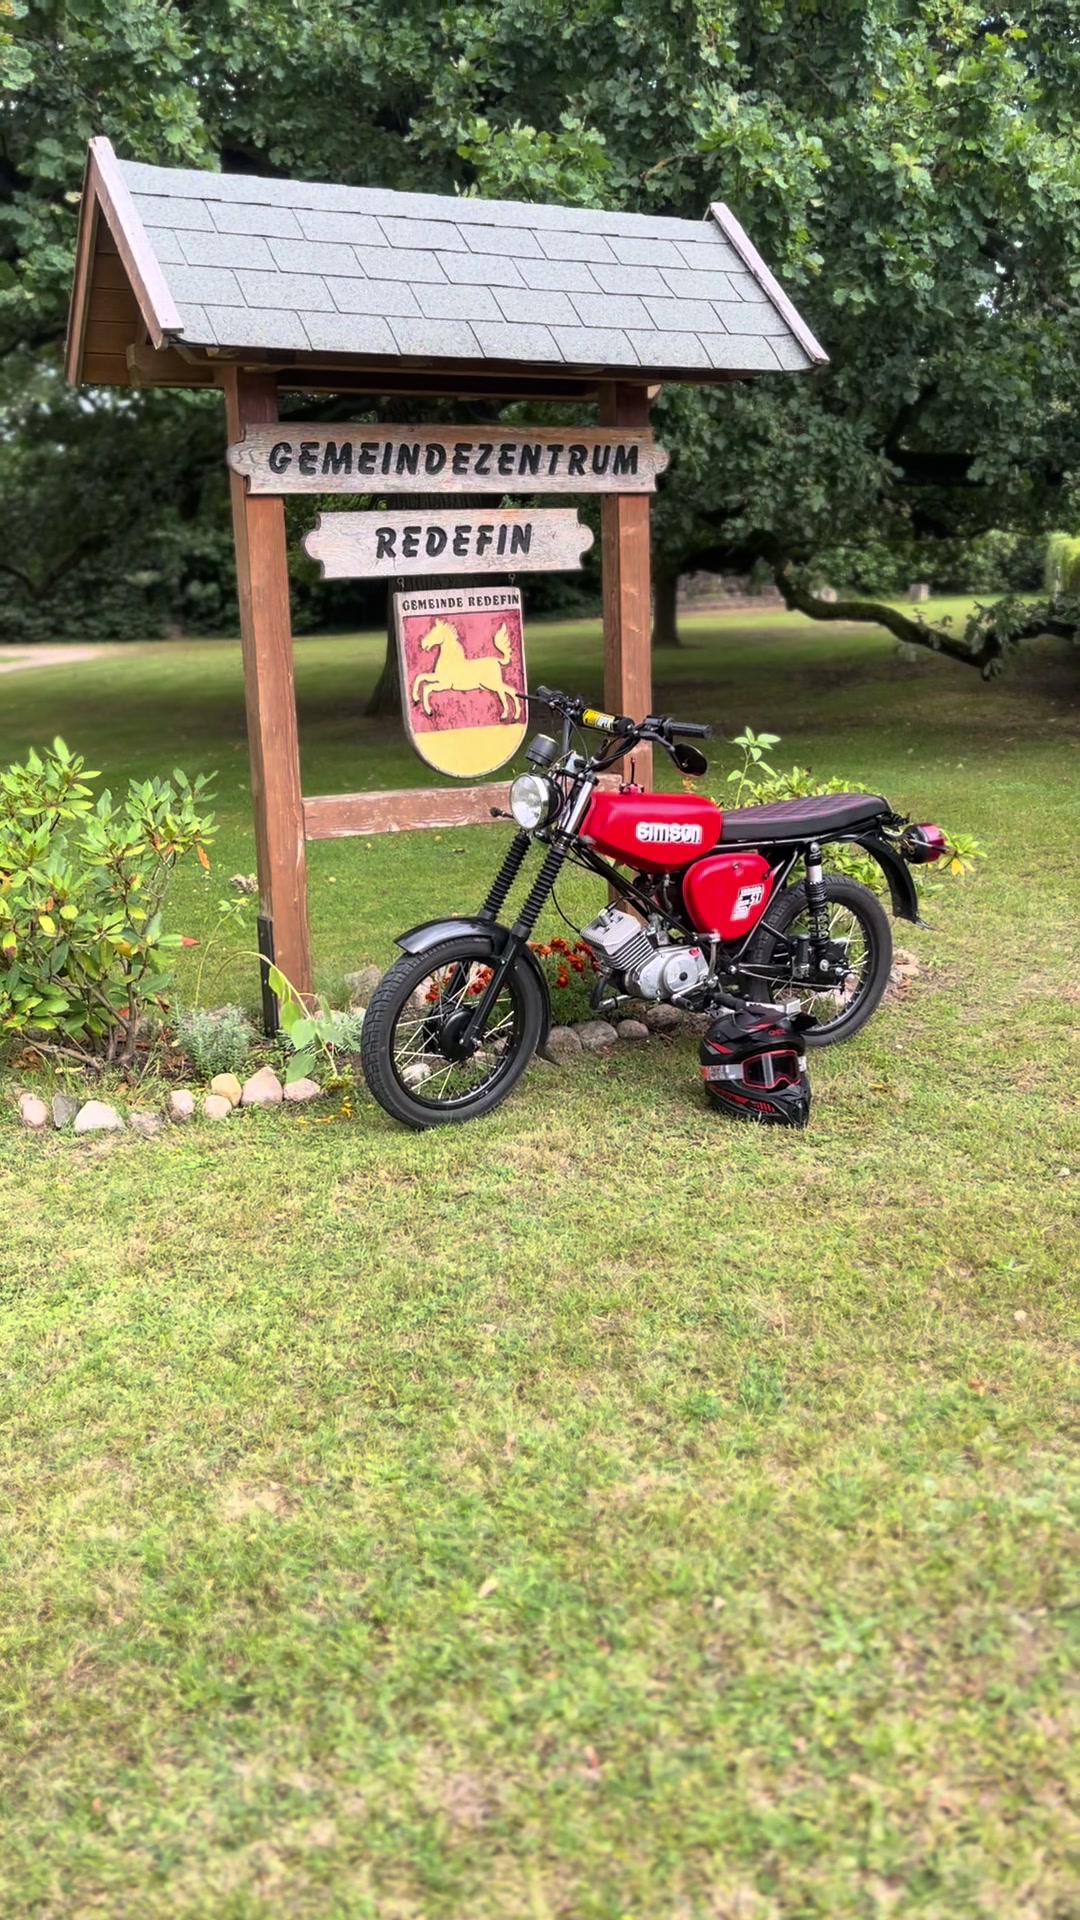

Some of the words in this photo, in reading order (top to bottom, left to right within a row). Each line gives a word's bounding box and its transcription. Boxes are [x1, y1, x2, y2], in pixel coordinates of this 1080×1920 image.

[268, 441, 639, 476] GEMEINDEZENTRUM
[375, 523, 532, 559] REDEFIN
[402, 597, 463, 611] GEMEINDE
[468, 594, 519, 607] REDEFIN
